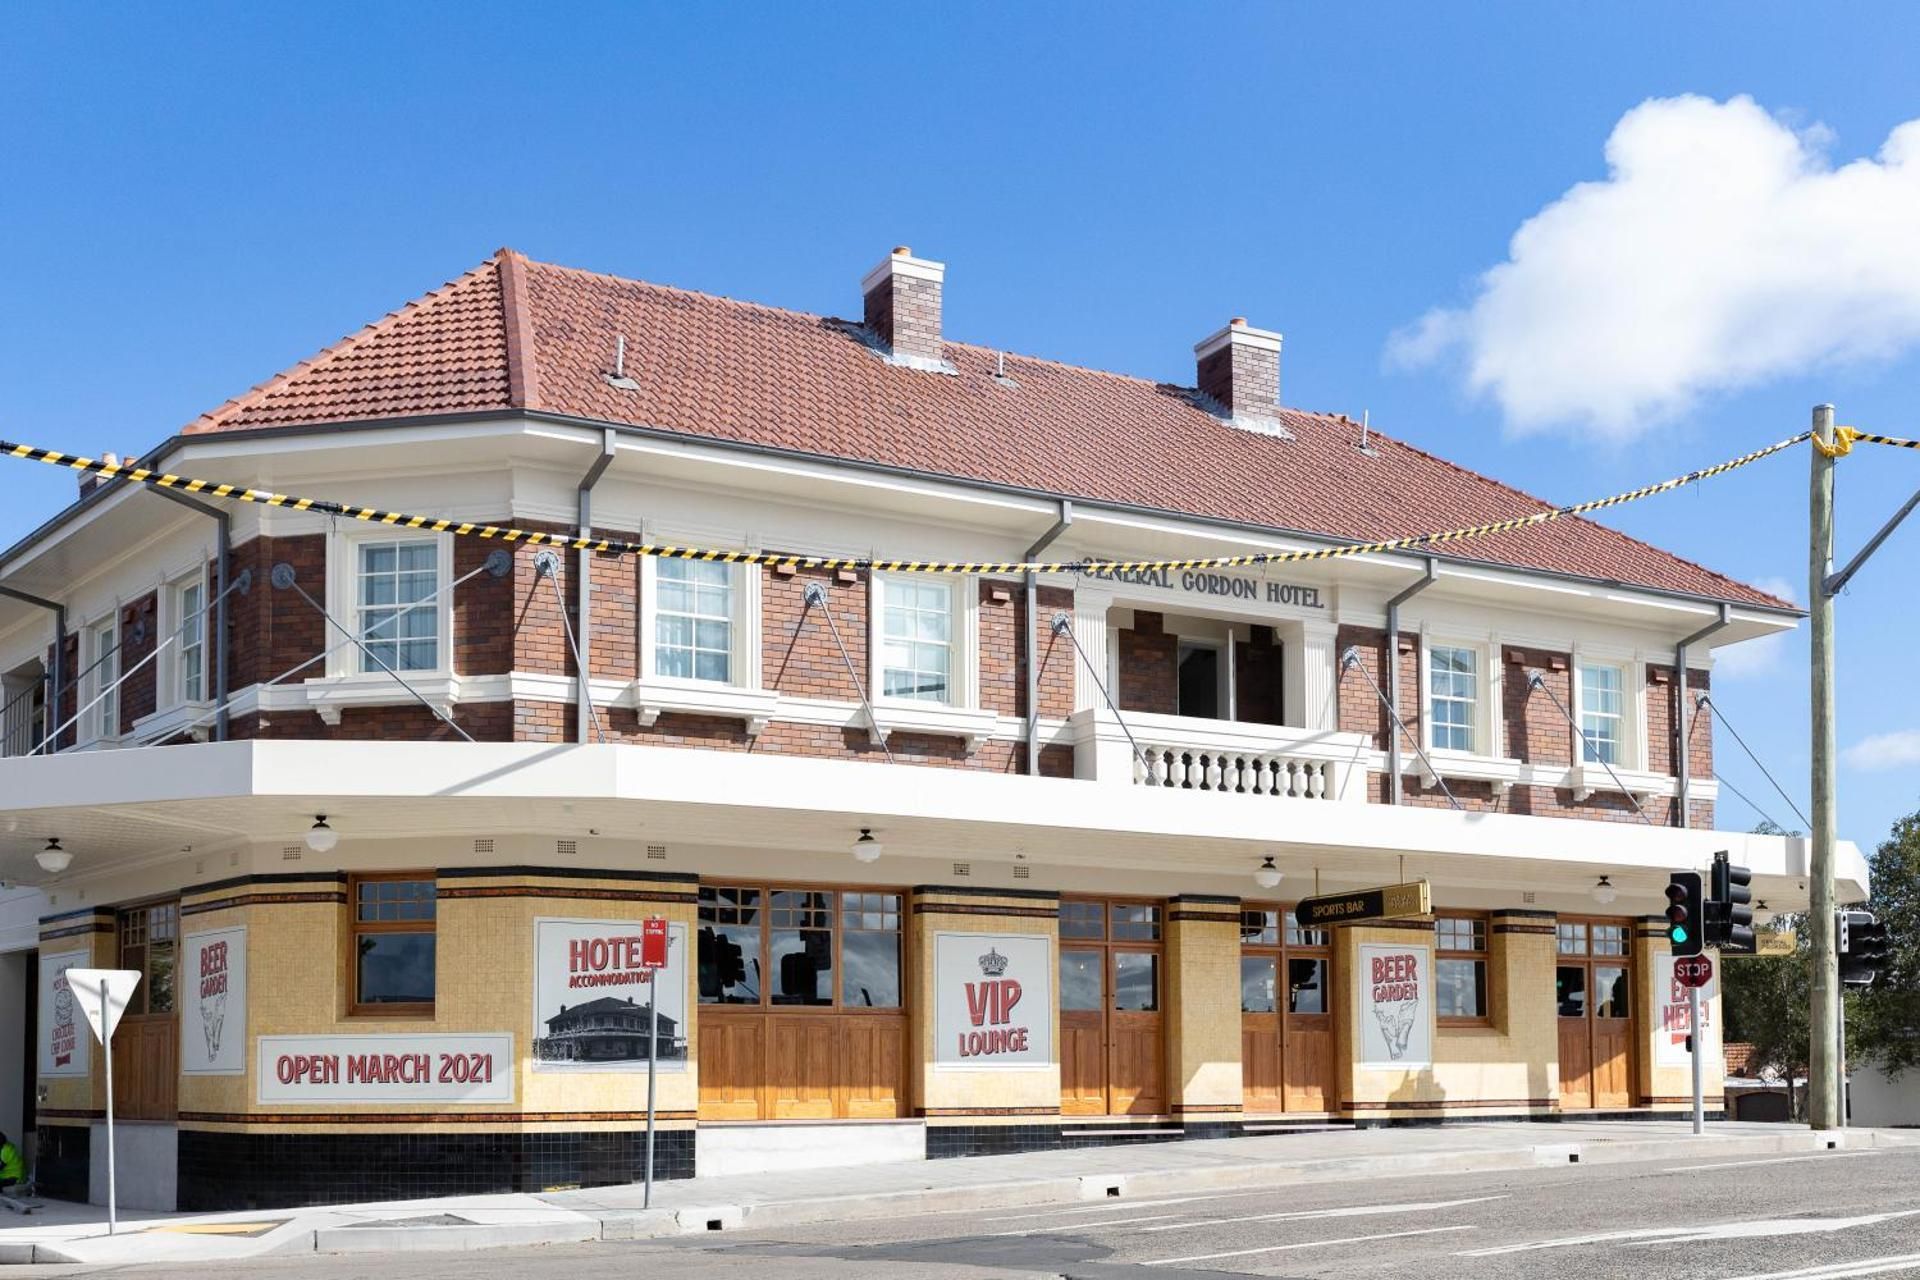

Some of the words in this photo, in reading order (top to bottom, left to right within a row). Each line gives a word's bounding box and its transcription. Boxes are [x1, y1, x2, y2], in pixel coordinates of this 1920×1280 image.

[1182, 571, 1257, 599] GORDON
[1266, 582, 1324, 608] HOTEL
[1312, 903, 1345, 917] SPORTS
[1346, 900, 1364, 913] BAR
[201, 940, 227, 977] BEER
[569, 936, 657, 972] HOTE
[1372, 954, 1417, 984] BEER
[1677, 963, 1709, 977] STOP
[201, 972, 227, 999] GARDEN
[1373, 982, 1418, 1003] GARDEN
[964, 979, 1022, 1026] VIP
[959, 1027, 1028, 1057] LOUNGE
[277, 1055, 339, 1083] OPEN
[347, 1054, 430, 1083] MARCH
[438, 1053, 492, 1083] 2021
